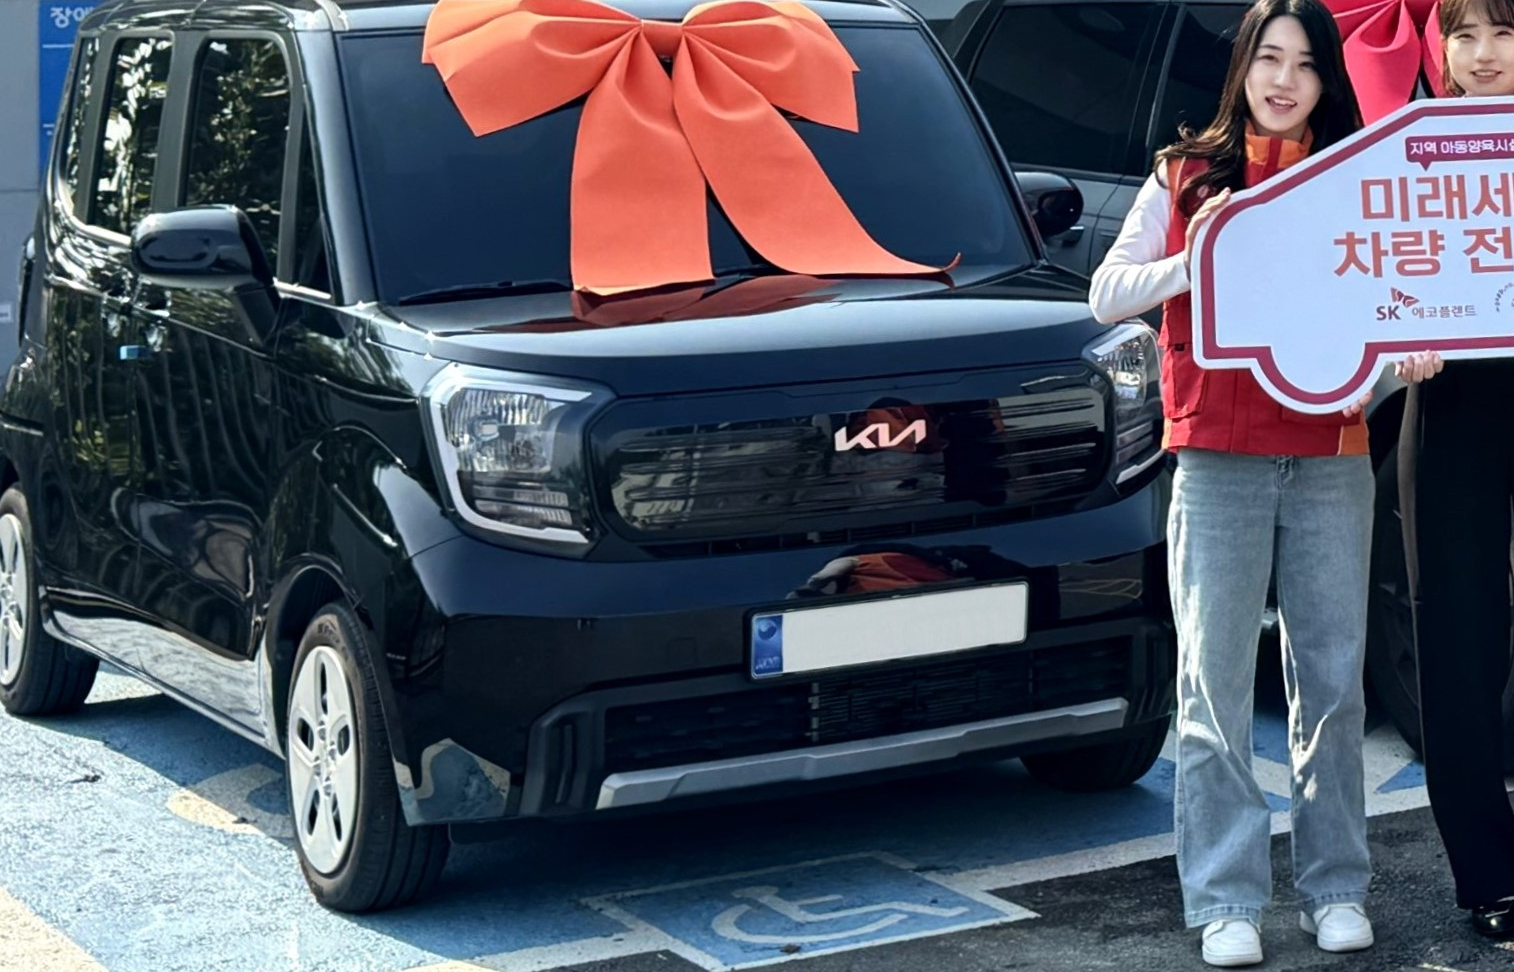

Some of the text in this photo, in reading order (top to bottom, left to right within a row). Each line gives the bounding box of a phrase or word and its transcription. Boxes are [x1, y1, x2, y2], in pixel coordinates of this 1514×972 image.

[1410, 141, 1437, 155] 지역
[1333, 229, 1445, 278] 차량
[1376, 305, 1401, 321] SK
